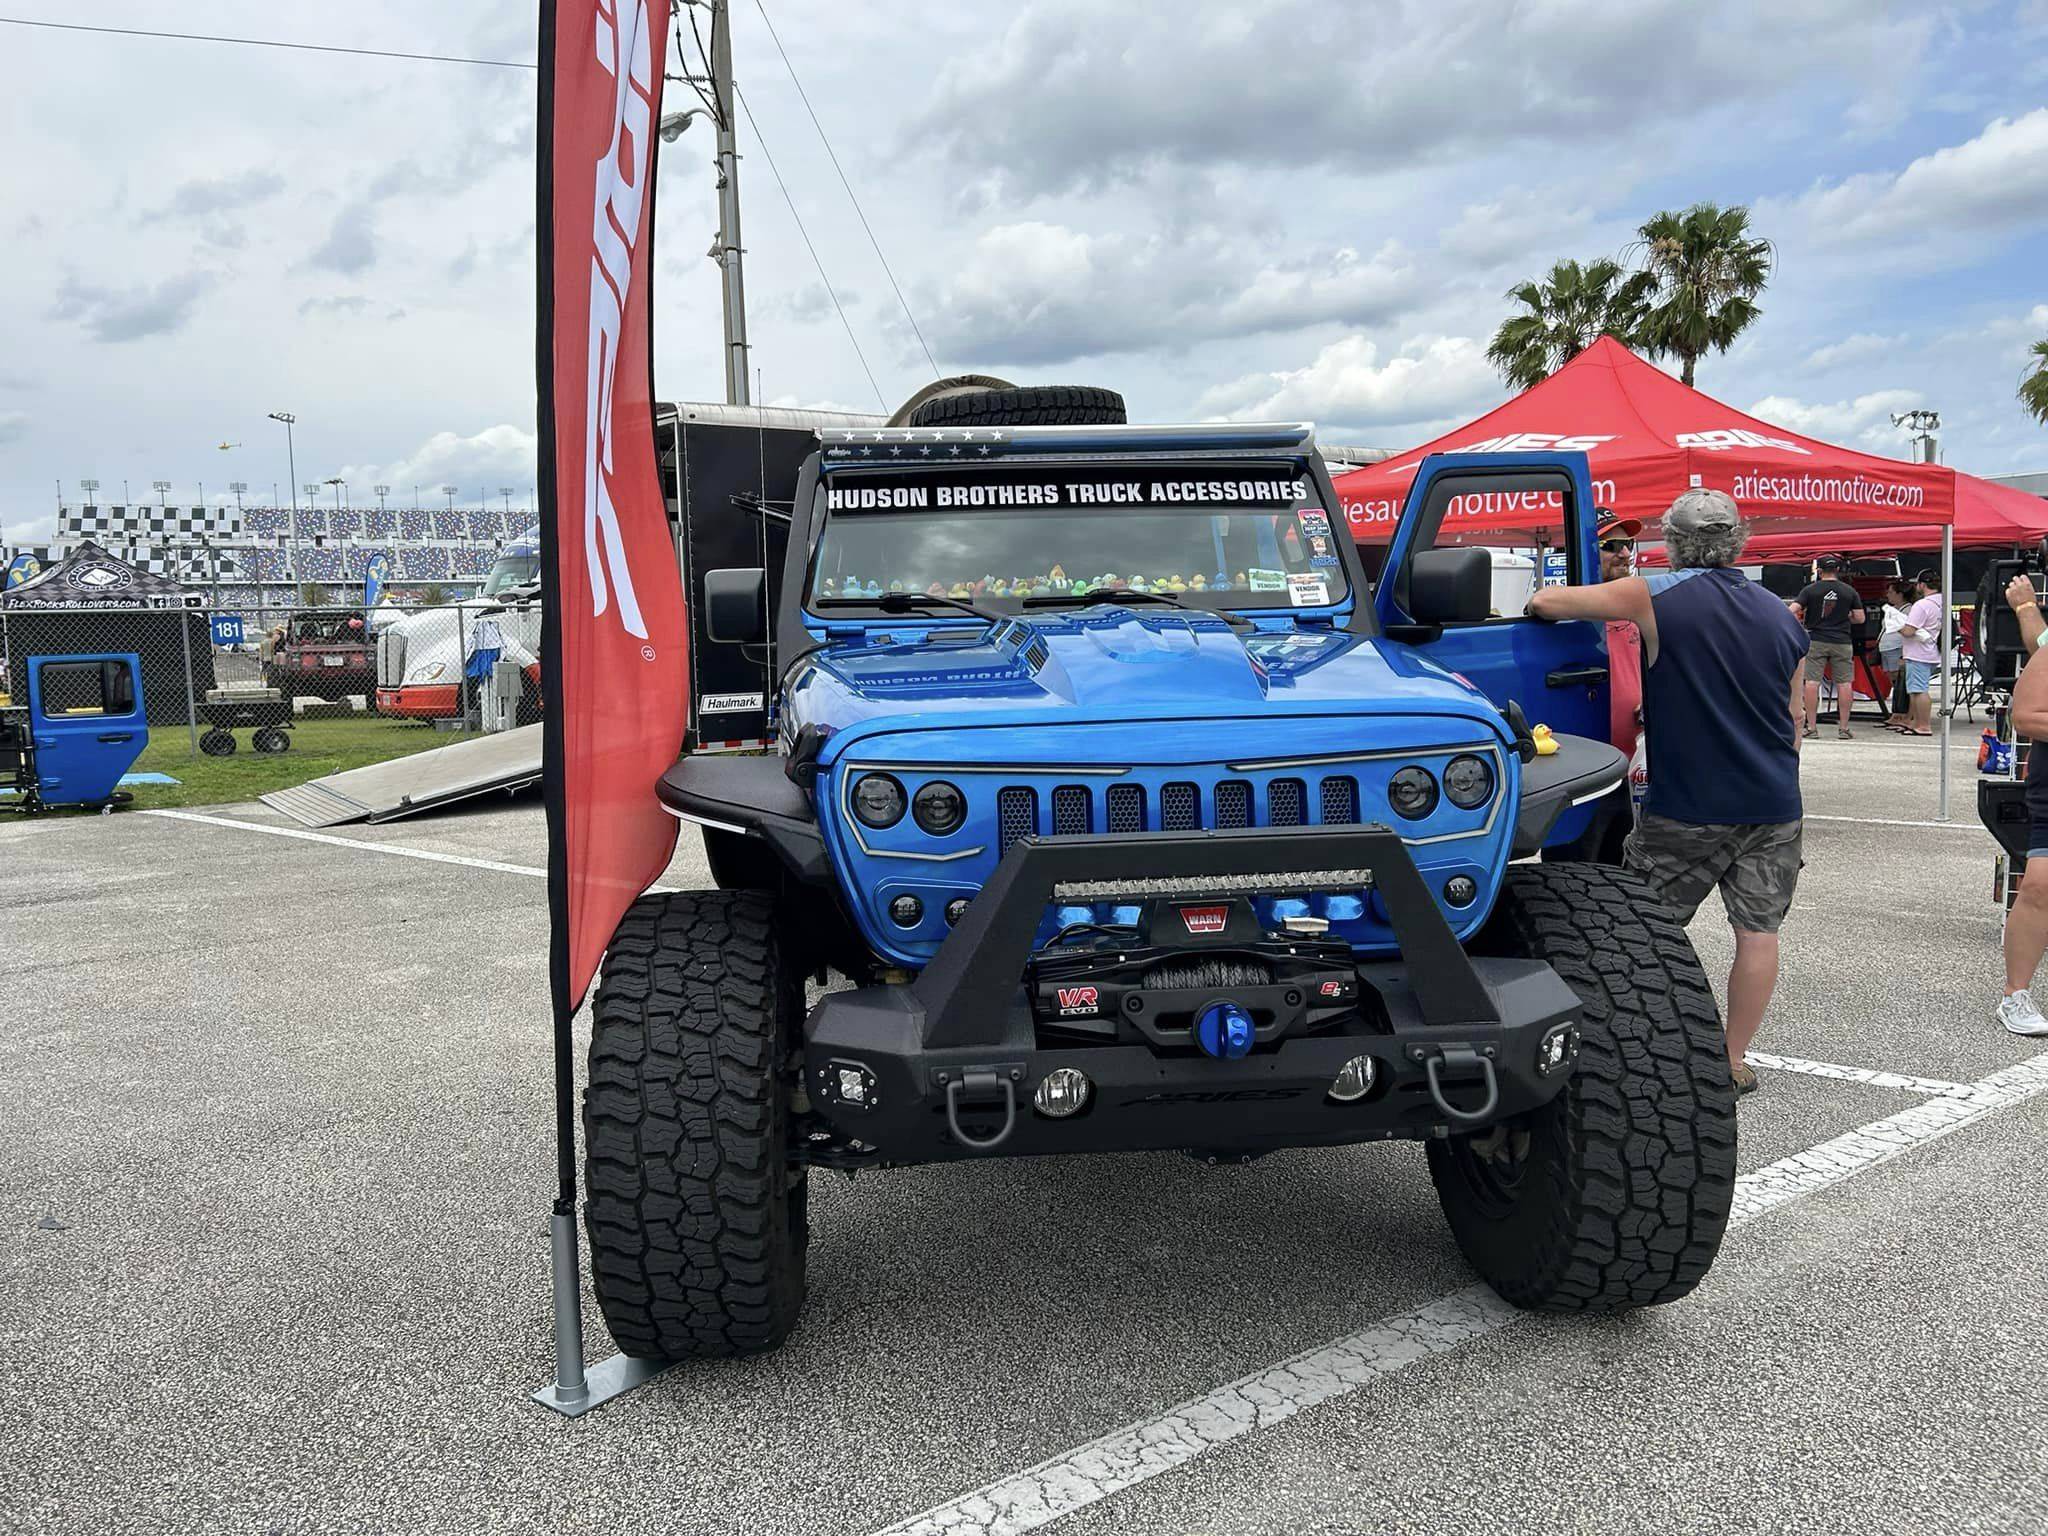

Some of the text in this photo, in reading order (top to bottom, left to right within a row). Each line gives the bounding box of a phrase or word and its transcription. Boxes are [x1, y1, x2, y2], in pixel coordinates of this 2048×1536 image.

[828, 480, 1308, 509] HUDSON BROTHERS TRUCK ACCESSORIES
[1733, 468, 1924, 508] ariesautomotive.com
[216, 622, 239, 637] 181
[707, 696, 757, 709] Haulmark
[1188, 914, 1222, 926] WARN
[1057, 986, 1099, 1008] VR
[1062, 1006, 1097, 1016] EVO
[1119, 1087, 1310, 1107] ARIES
